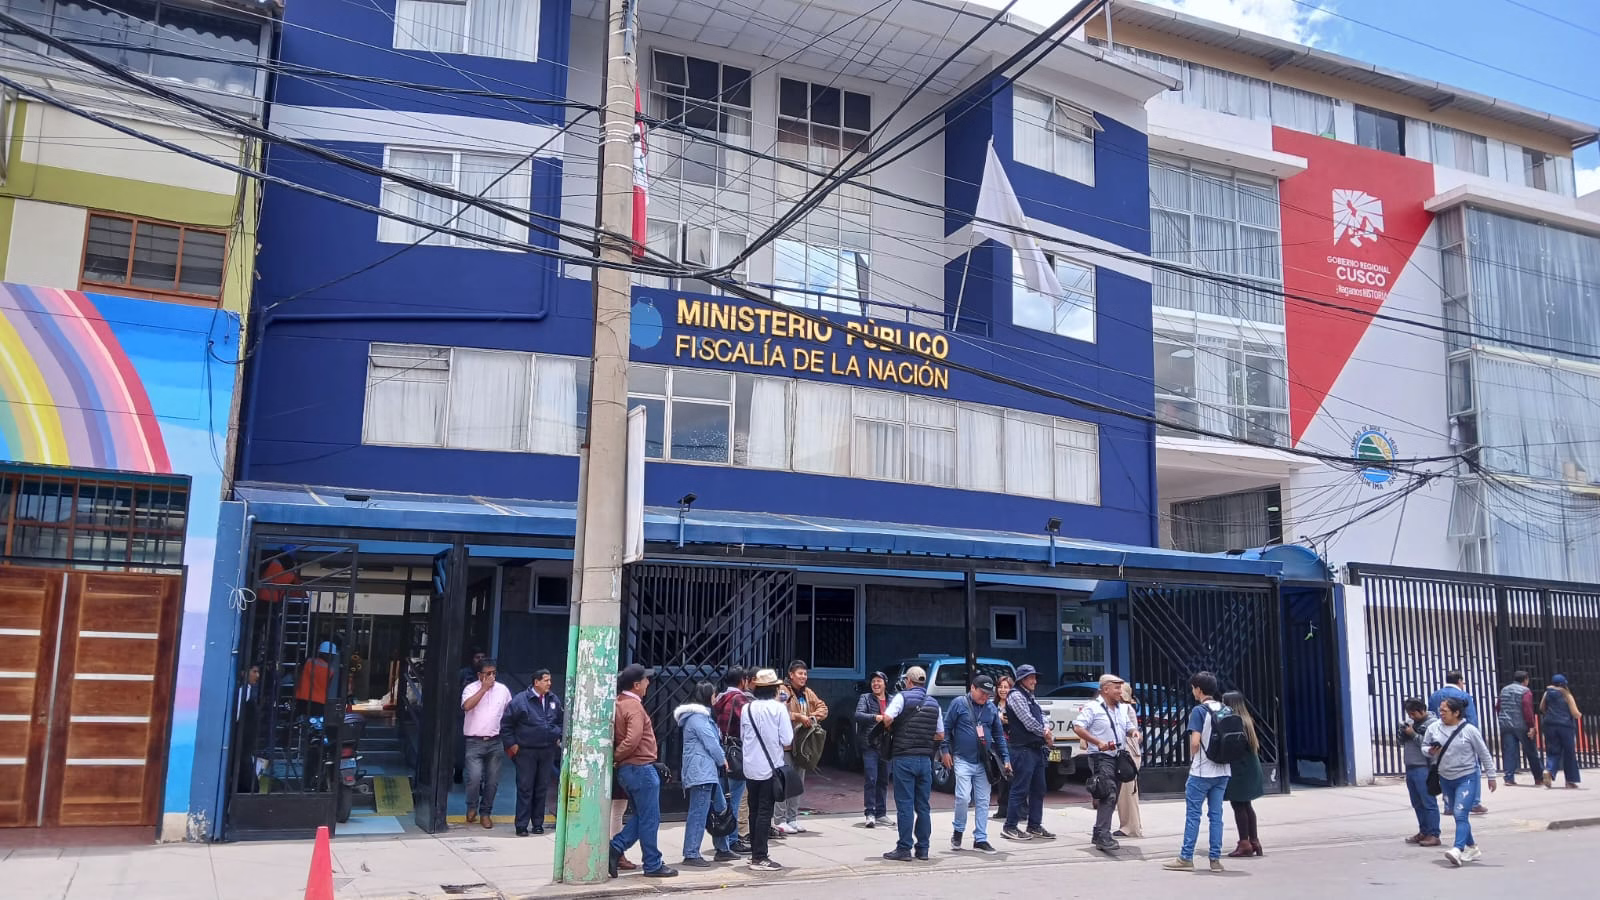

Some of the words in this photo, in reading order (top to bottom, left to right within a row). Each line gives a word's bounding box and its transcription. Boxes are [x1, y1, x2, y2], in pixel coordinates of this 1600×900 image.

[1327, 256, 1359, 267] GOBIERNO
[1360, 261, 1391, 274] REGIONAL
[1336, 266, 1386, 286] CUSCO
[677, 299, 832, 341] MINISTERIO
[676, 334, 787, 368] FISCALÍA
[793, 348, 825, 373] DE
[831, 352, 861, 378] LA
[868, 357, 949, 390] NACIÓN
[1049, 721, 1074, 731] OTA
